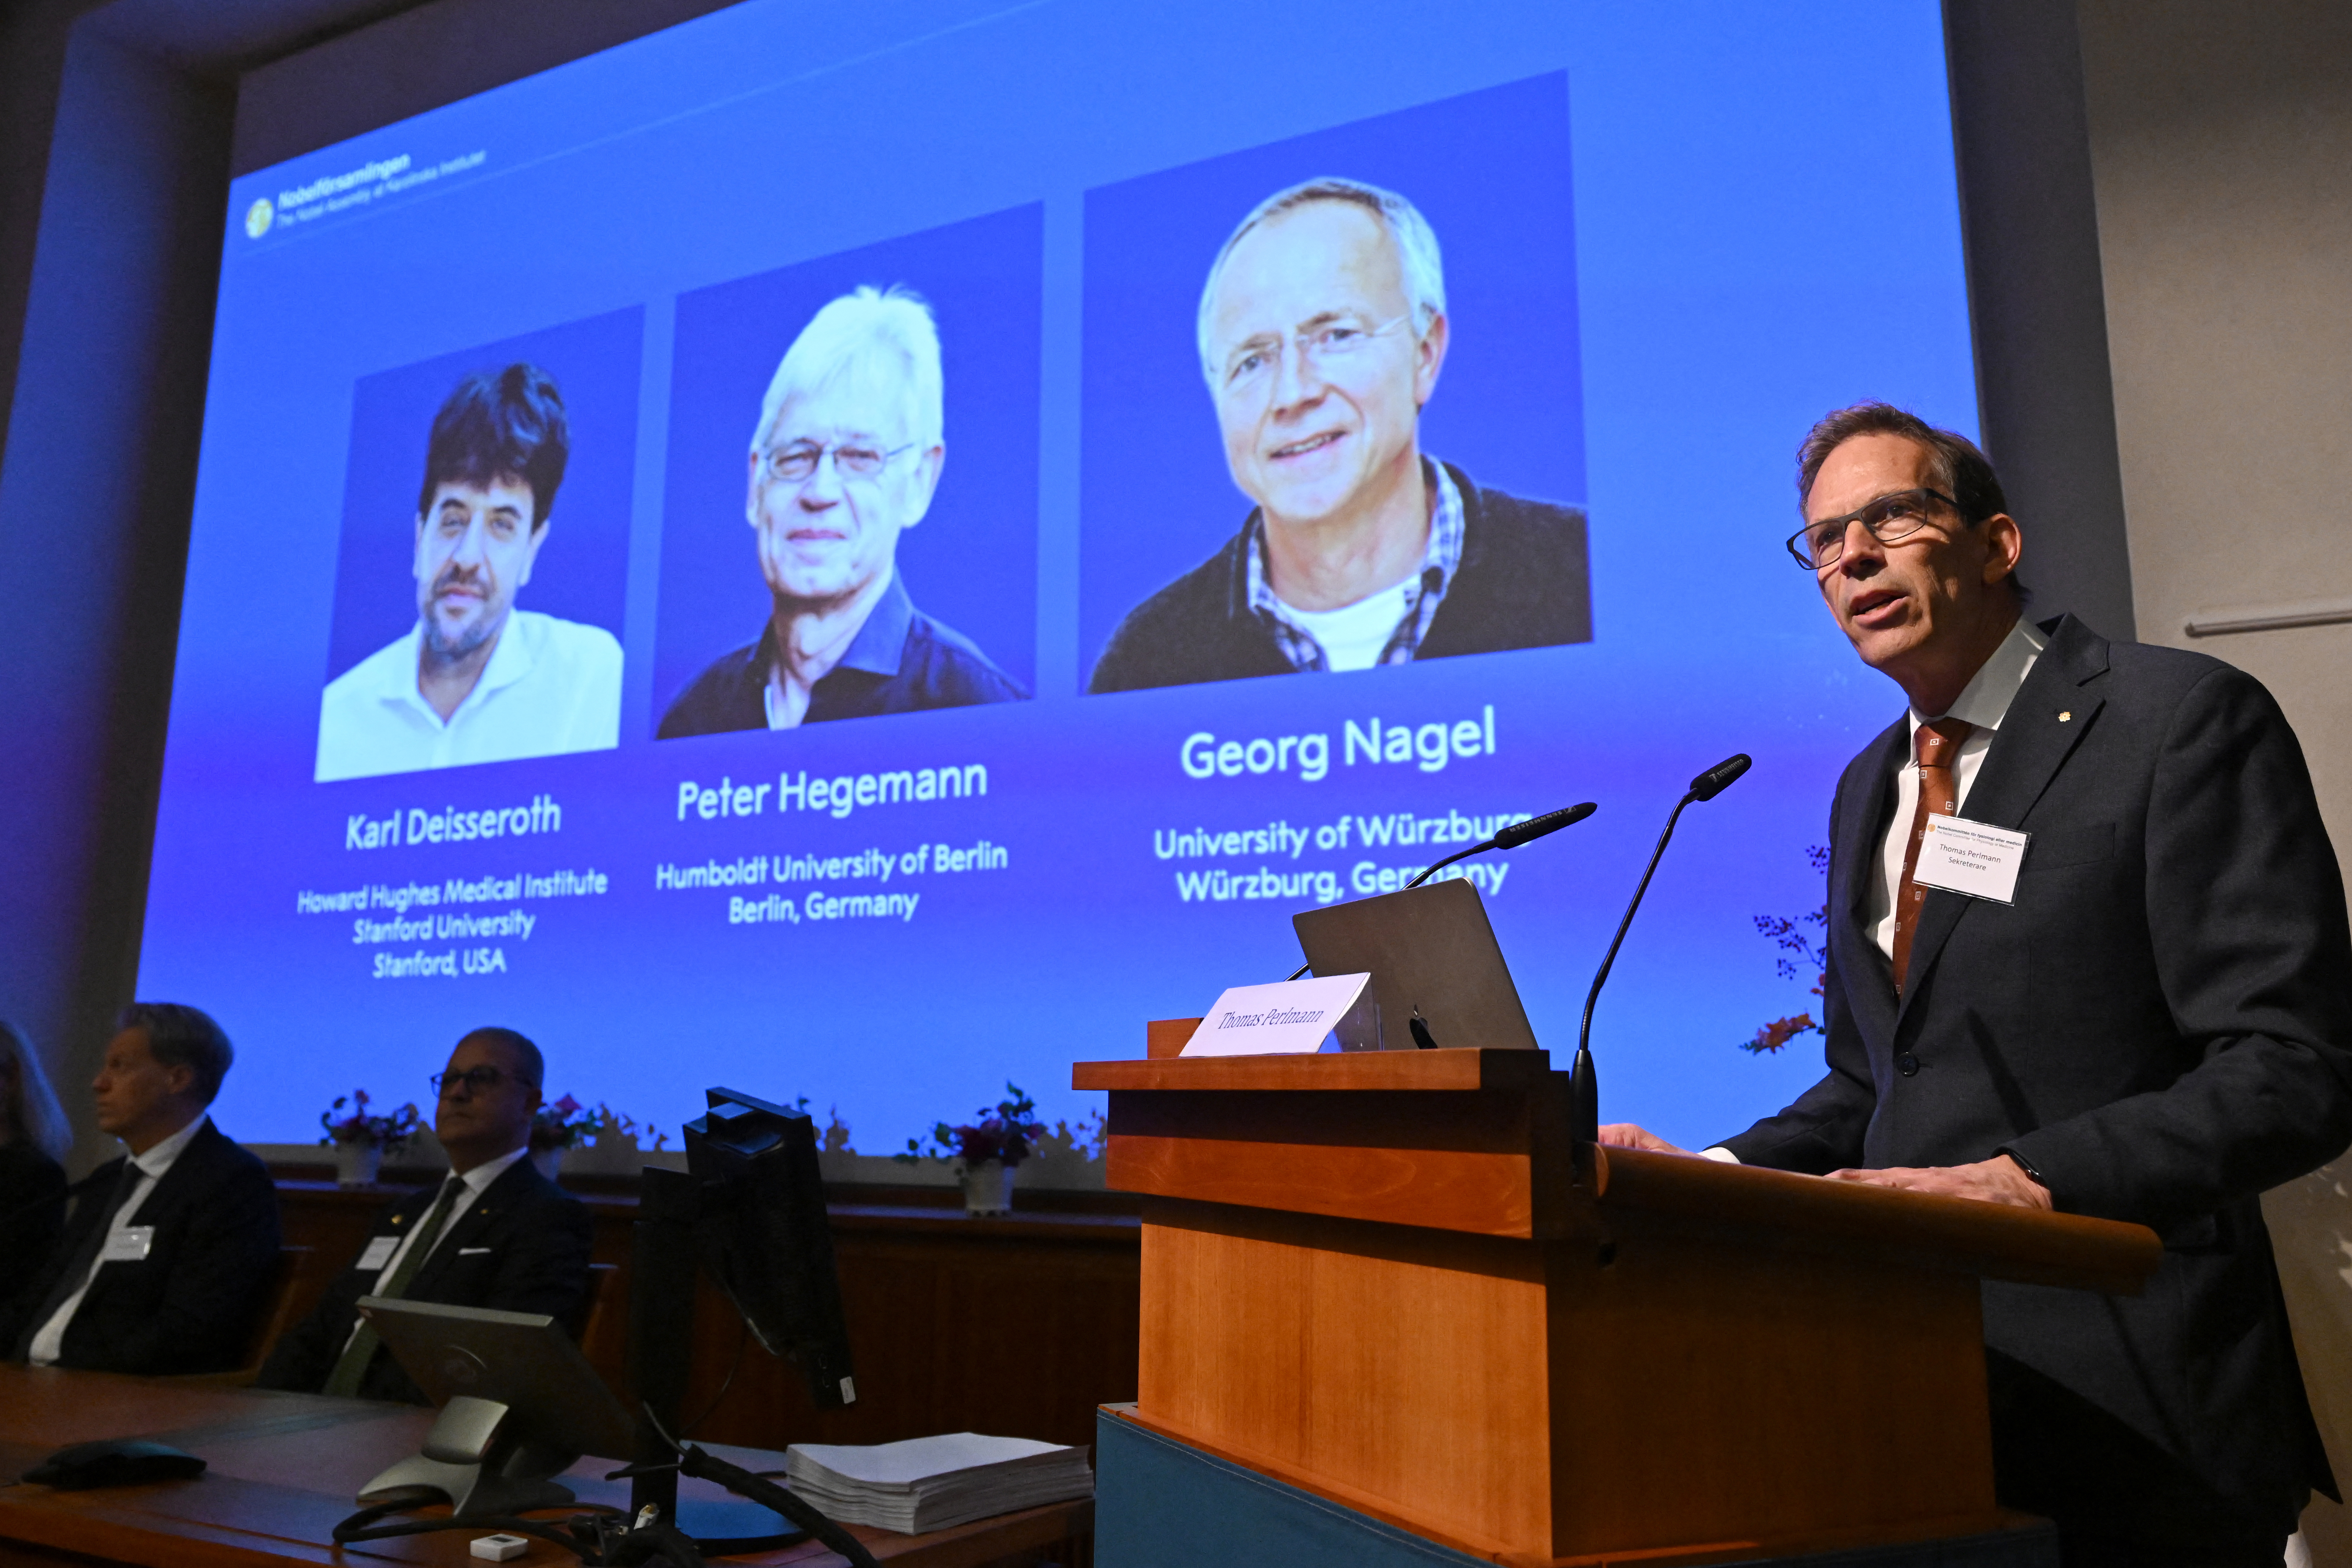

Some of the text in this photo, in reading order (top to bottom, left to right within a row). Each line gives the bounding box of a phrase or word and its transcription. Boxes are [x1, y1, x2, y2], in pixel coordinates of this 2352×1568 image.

[1181, 704, 1496, 781] Georg Nagel
[677, 764, 987, 821] Peter Hegemann
[346, 793, 561, 851] Karl Deisseroth
[1154, 808, 1533, 859] University of Würzbur
[1509, 810, 1563, 832] SENNHEISER
[1937, 825, 1970, 835] Nobelkommittén
[656, 840, 1008, 890] Humboldt University of Berlin
[1940, 843, 2001, 863] Thomas Perlmann
[1948, 856, 1987, 871] Sekreterare
[297, 867, 608, 914] Howard Hughes Medical Institute
[1176, 866, 1344, 904] Würzburg,
[729, 890, 920, 925] Berlin, Germany
[352, 908, 537, 945] Stanford University
[372, 947, 508, 979] Stanford, USA
[1218, 1007, 1324, 1029] Thomas Perlmann
